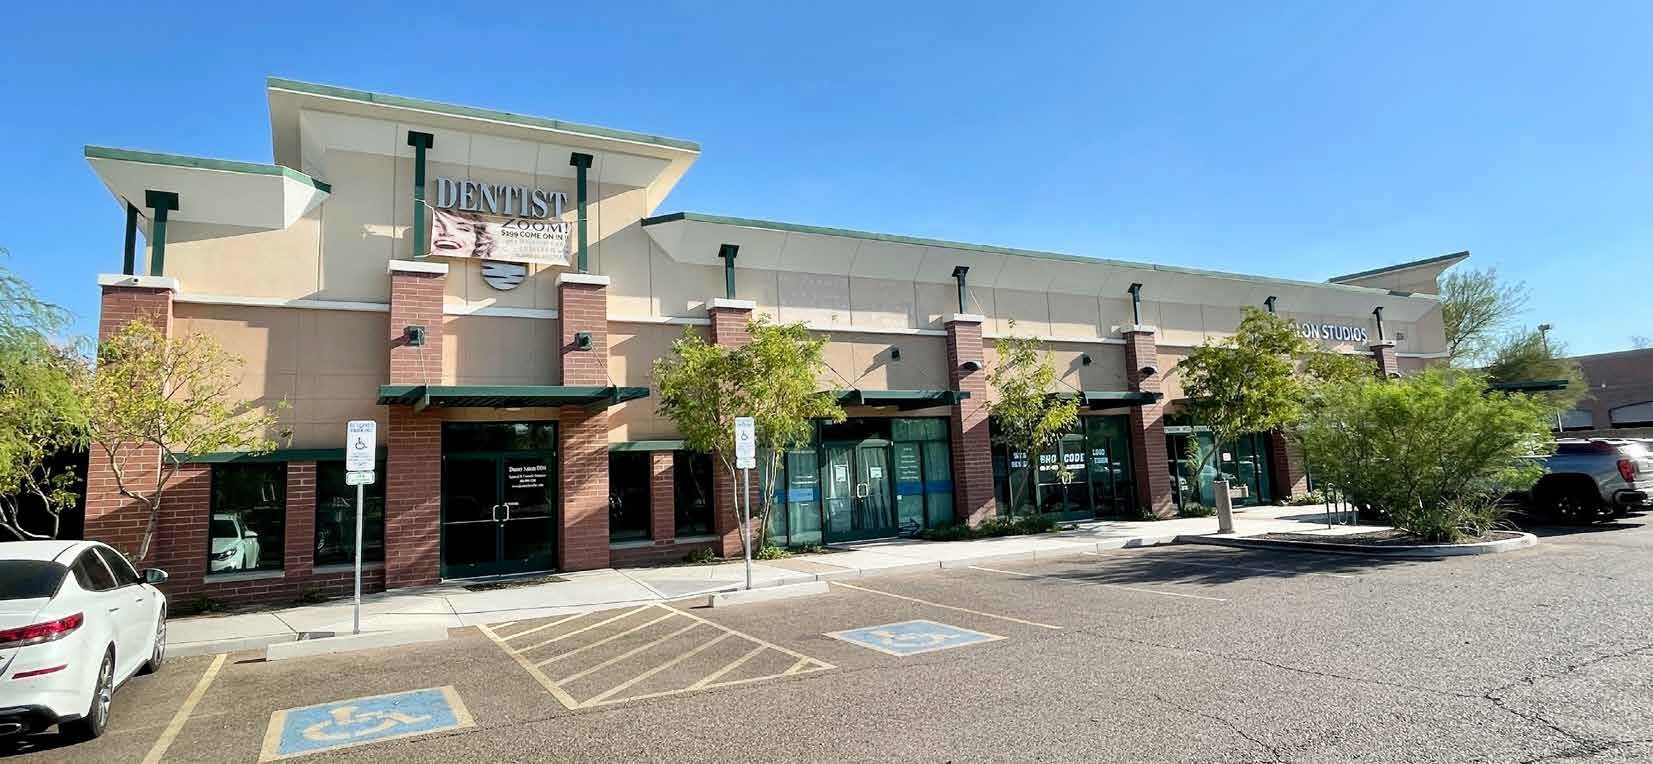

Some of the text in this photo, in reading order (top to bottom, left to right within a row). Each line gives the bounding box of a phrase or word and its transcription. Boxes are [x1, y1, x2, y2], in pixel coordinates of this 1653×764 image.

[436, 176, 568, 218] DENTIST
[501, 218, 568, 234] ZOOM!
[501, 229, 519, 238] $199
[519, 231, 542, 239] COME
[1322, 324, 1368, 344] STUDIOS
[1063, 453, 1085, 463] CODE
